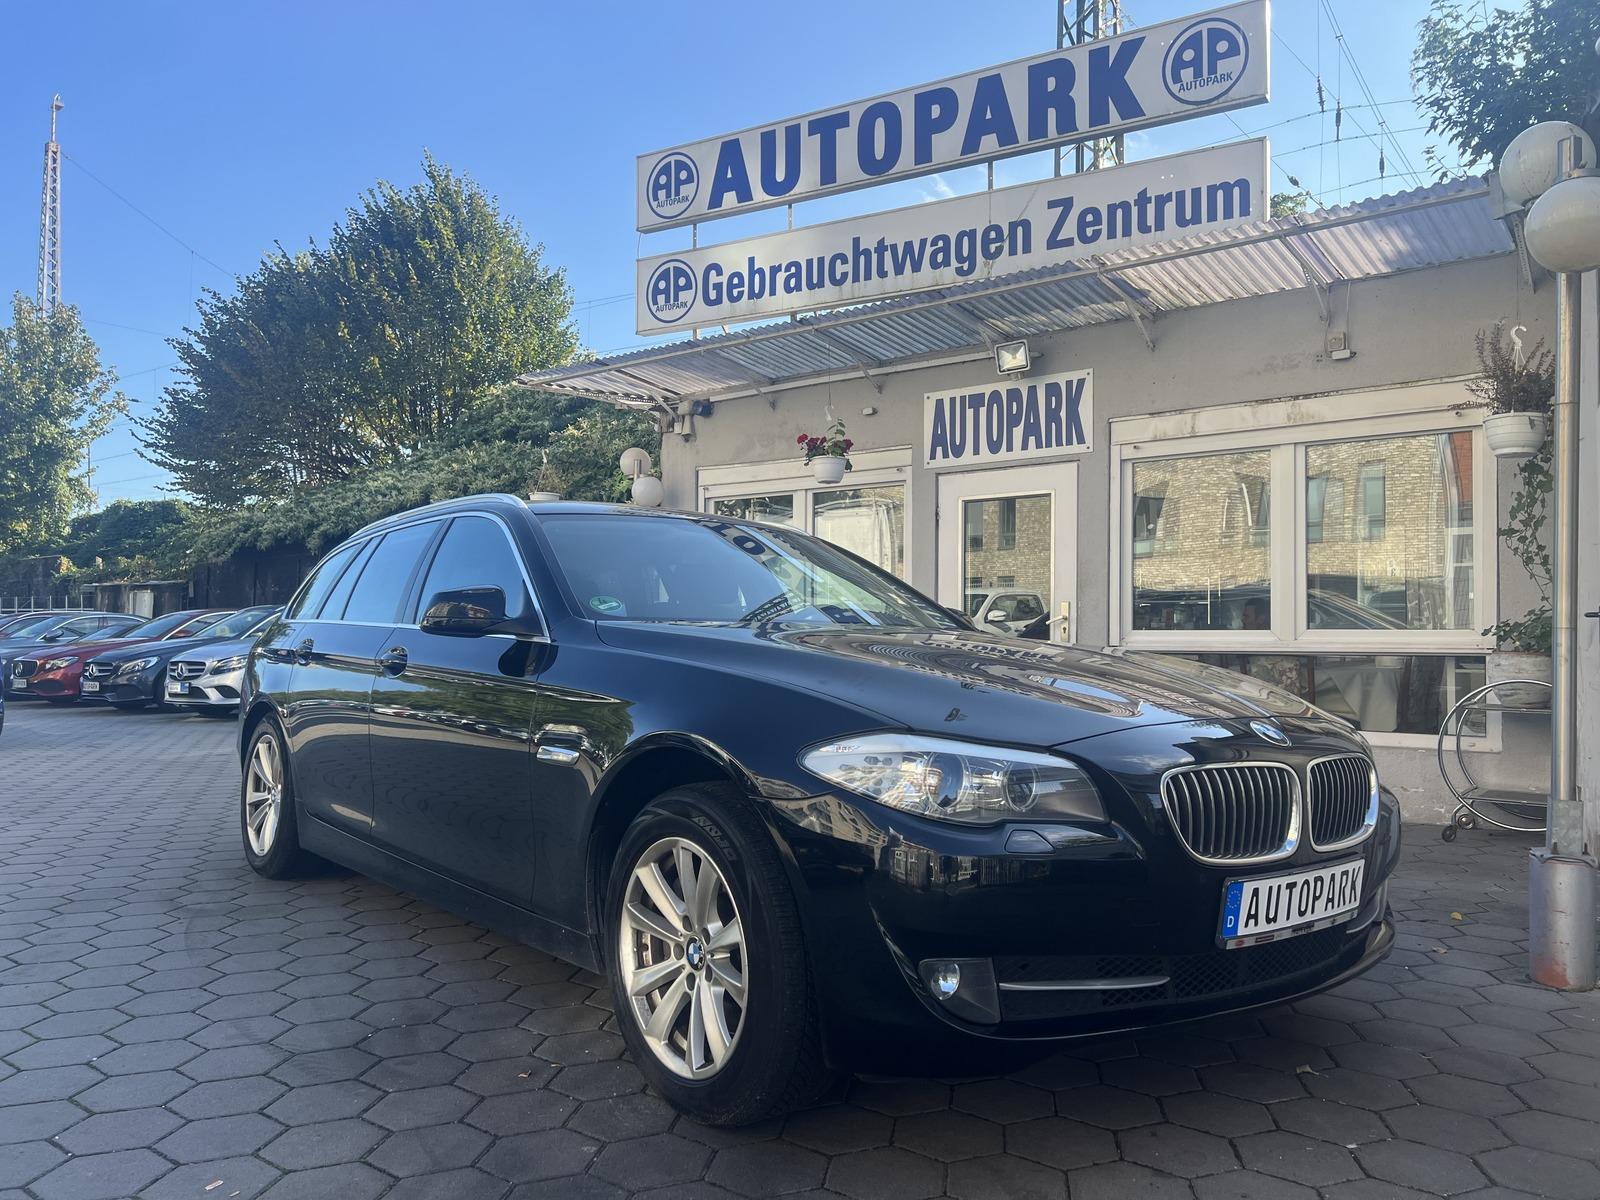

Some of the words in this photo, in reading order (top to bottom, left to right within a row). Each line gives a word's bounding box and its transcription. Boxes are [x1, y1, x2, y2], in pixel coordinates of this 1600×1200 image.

[1178, 71, 1234, 94] AUTOPARK
[706, 36, 1147, 211] AUTOPARK
[655, 194, 690, 209] AUTOPARK
[702, 218, 1032, 307] Gebrauchtwagen
[1046, 178, 1251, 250] Zentrum
[655, 300, 688, 313] AUTOPARK
[929, 377, 1086, 461] AUTOPARK
[1227, 915, 1235, 928] D
[1244, 865, 1361, 928] AUTOPARK
